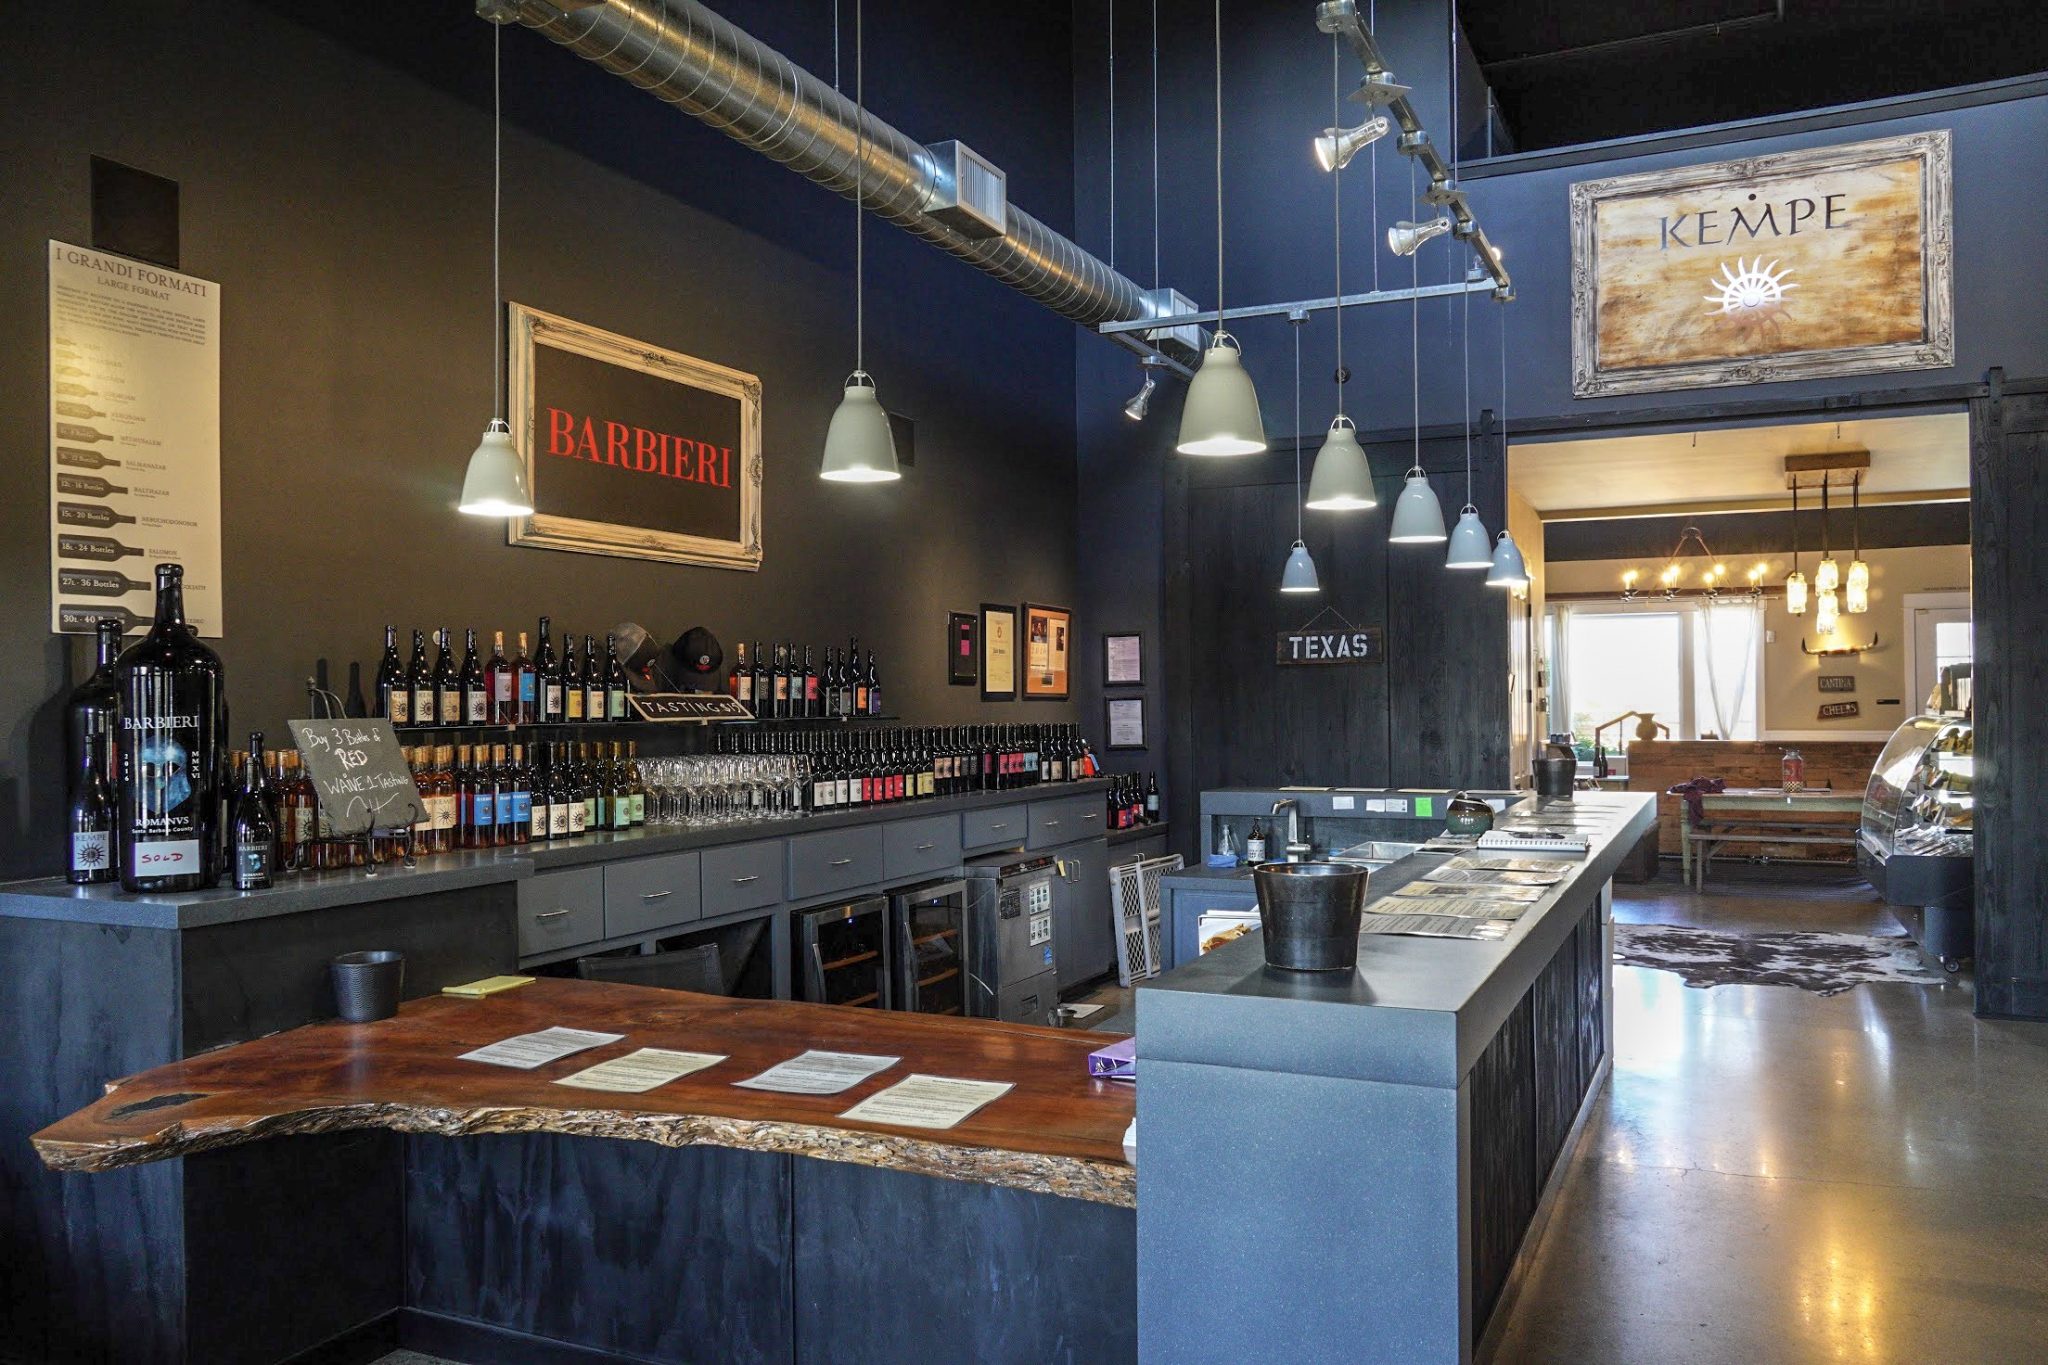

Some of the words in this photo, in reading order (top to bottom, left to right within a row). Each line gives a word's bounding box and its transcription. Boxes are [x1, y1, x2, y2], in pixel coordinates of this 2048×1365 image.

[1657, 193, 1847, 251] KEMPE
[56, 248, 62, 260] I
[67, 251, 132, 278] GRANDI
[138, 269, 207, 297] FORMATI
[97, 277, 130, 292] LARGE
[132, 286, 171, 301] FORMAT
[546, 407, 734, 489] BARBIERI
[87, 512, 110, 521] Bottles
[78, 543, 88, 552] 24
[90, 545, 114, 554] Bottles
[81, 578, 91, 587] 36
[93, 579, 119, 588] Bottles
[84, 615, 96, 624] 40
[1289, 634, 1368, 659] TEXAS
[641, 702, 720, 713] TASTING
[124, 715, 199, 730] BARBIERI
[302, 727, 330, 752] Buy
[332, 728, 343, 745] 3
[334, 748, 368, 771] RED
[367, 775, 378, 790] 1
[135, 817, 190, 827] ROMANVS
[173, 826, 194, 834] County
[141, 853, 184, 863] SOLD
